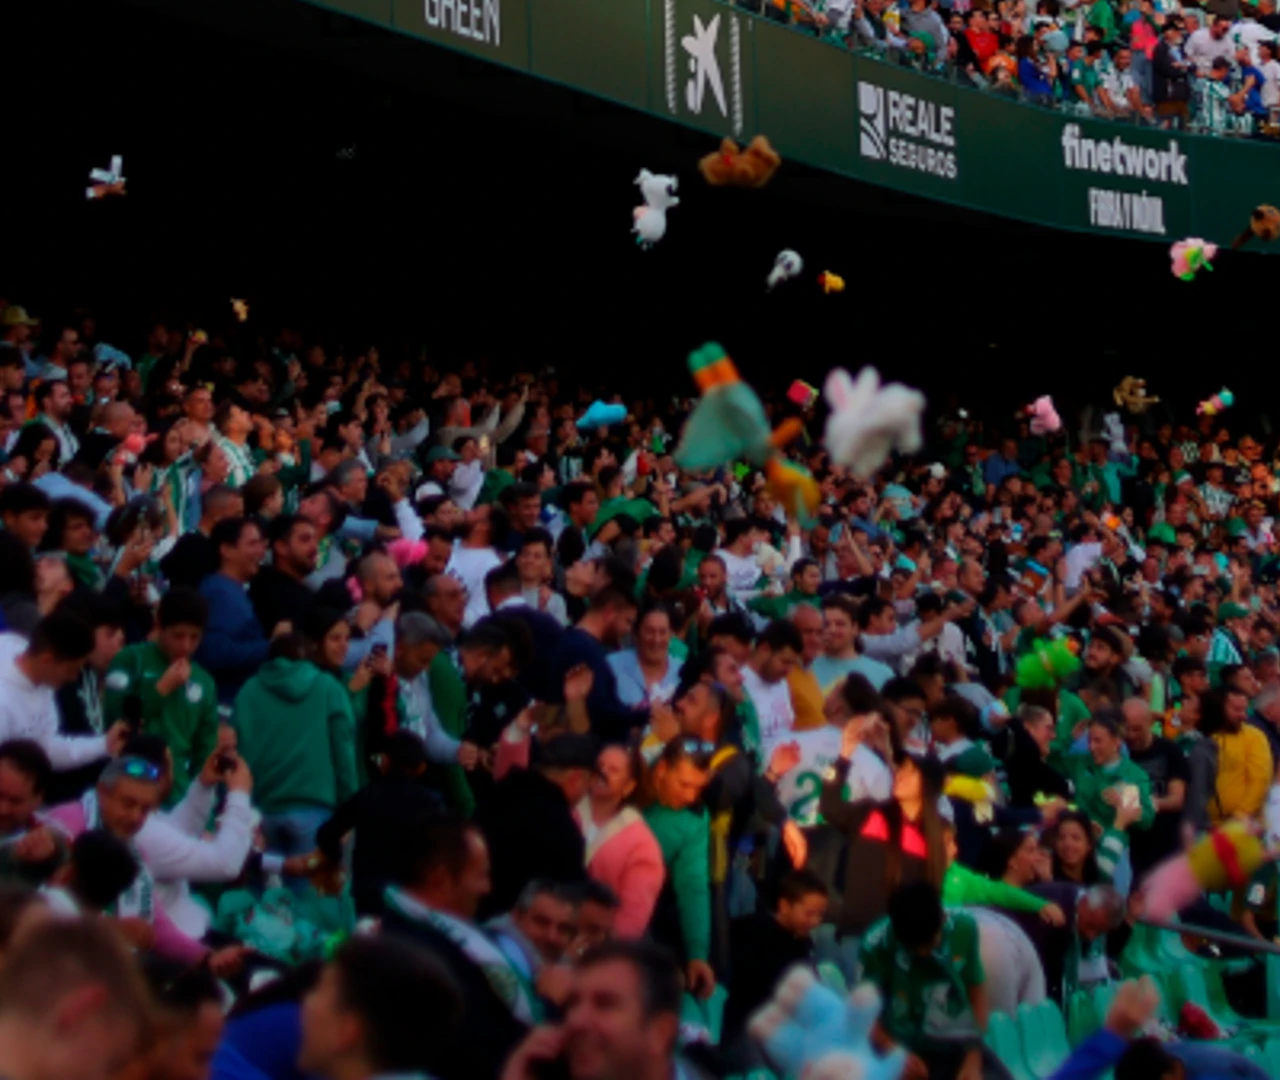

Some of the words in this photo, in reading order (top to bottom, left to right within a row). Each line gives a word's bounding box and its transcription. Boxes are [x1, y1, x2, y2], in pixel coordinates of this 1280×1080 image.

[887, 90, 955, 147] REALE
[888, 136, 958, 179] SEGUROS
[1061, 123, 1188, 185] finetwork
